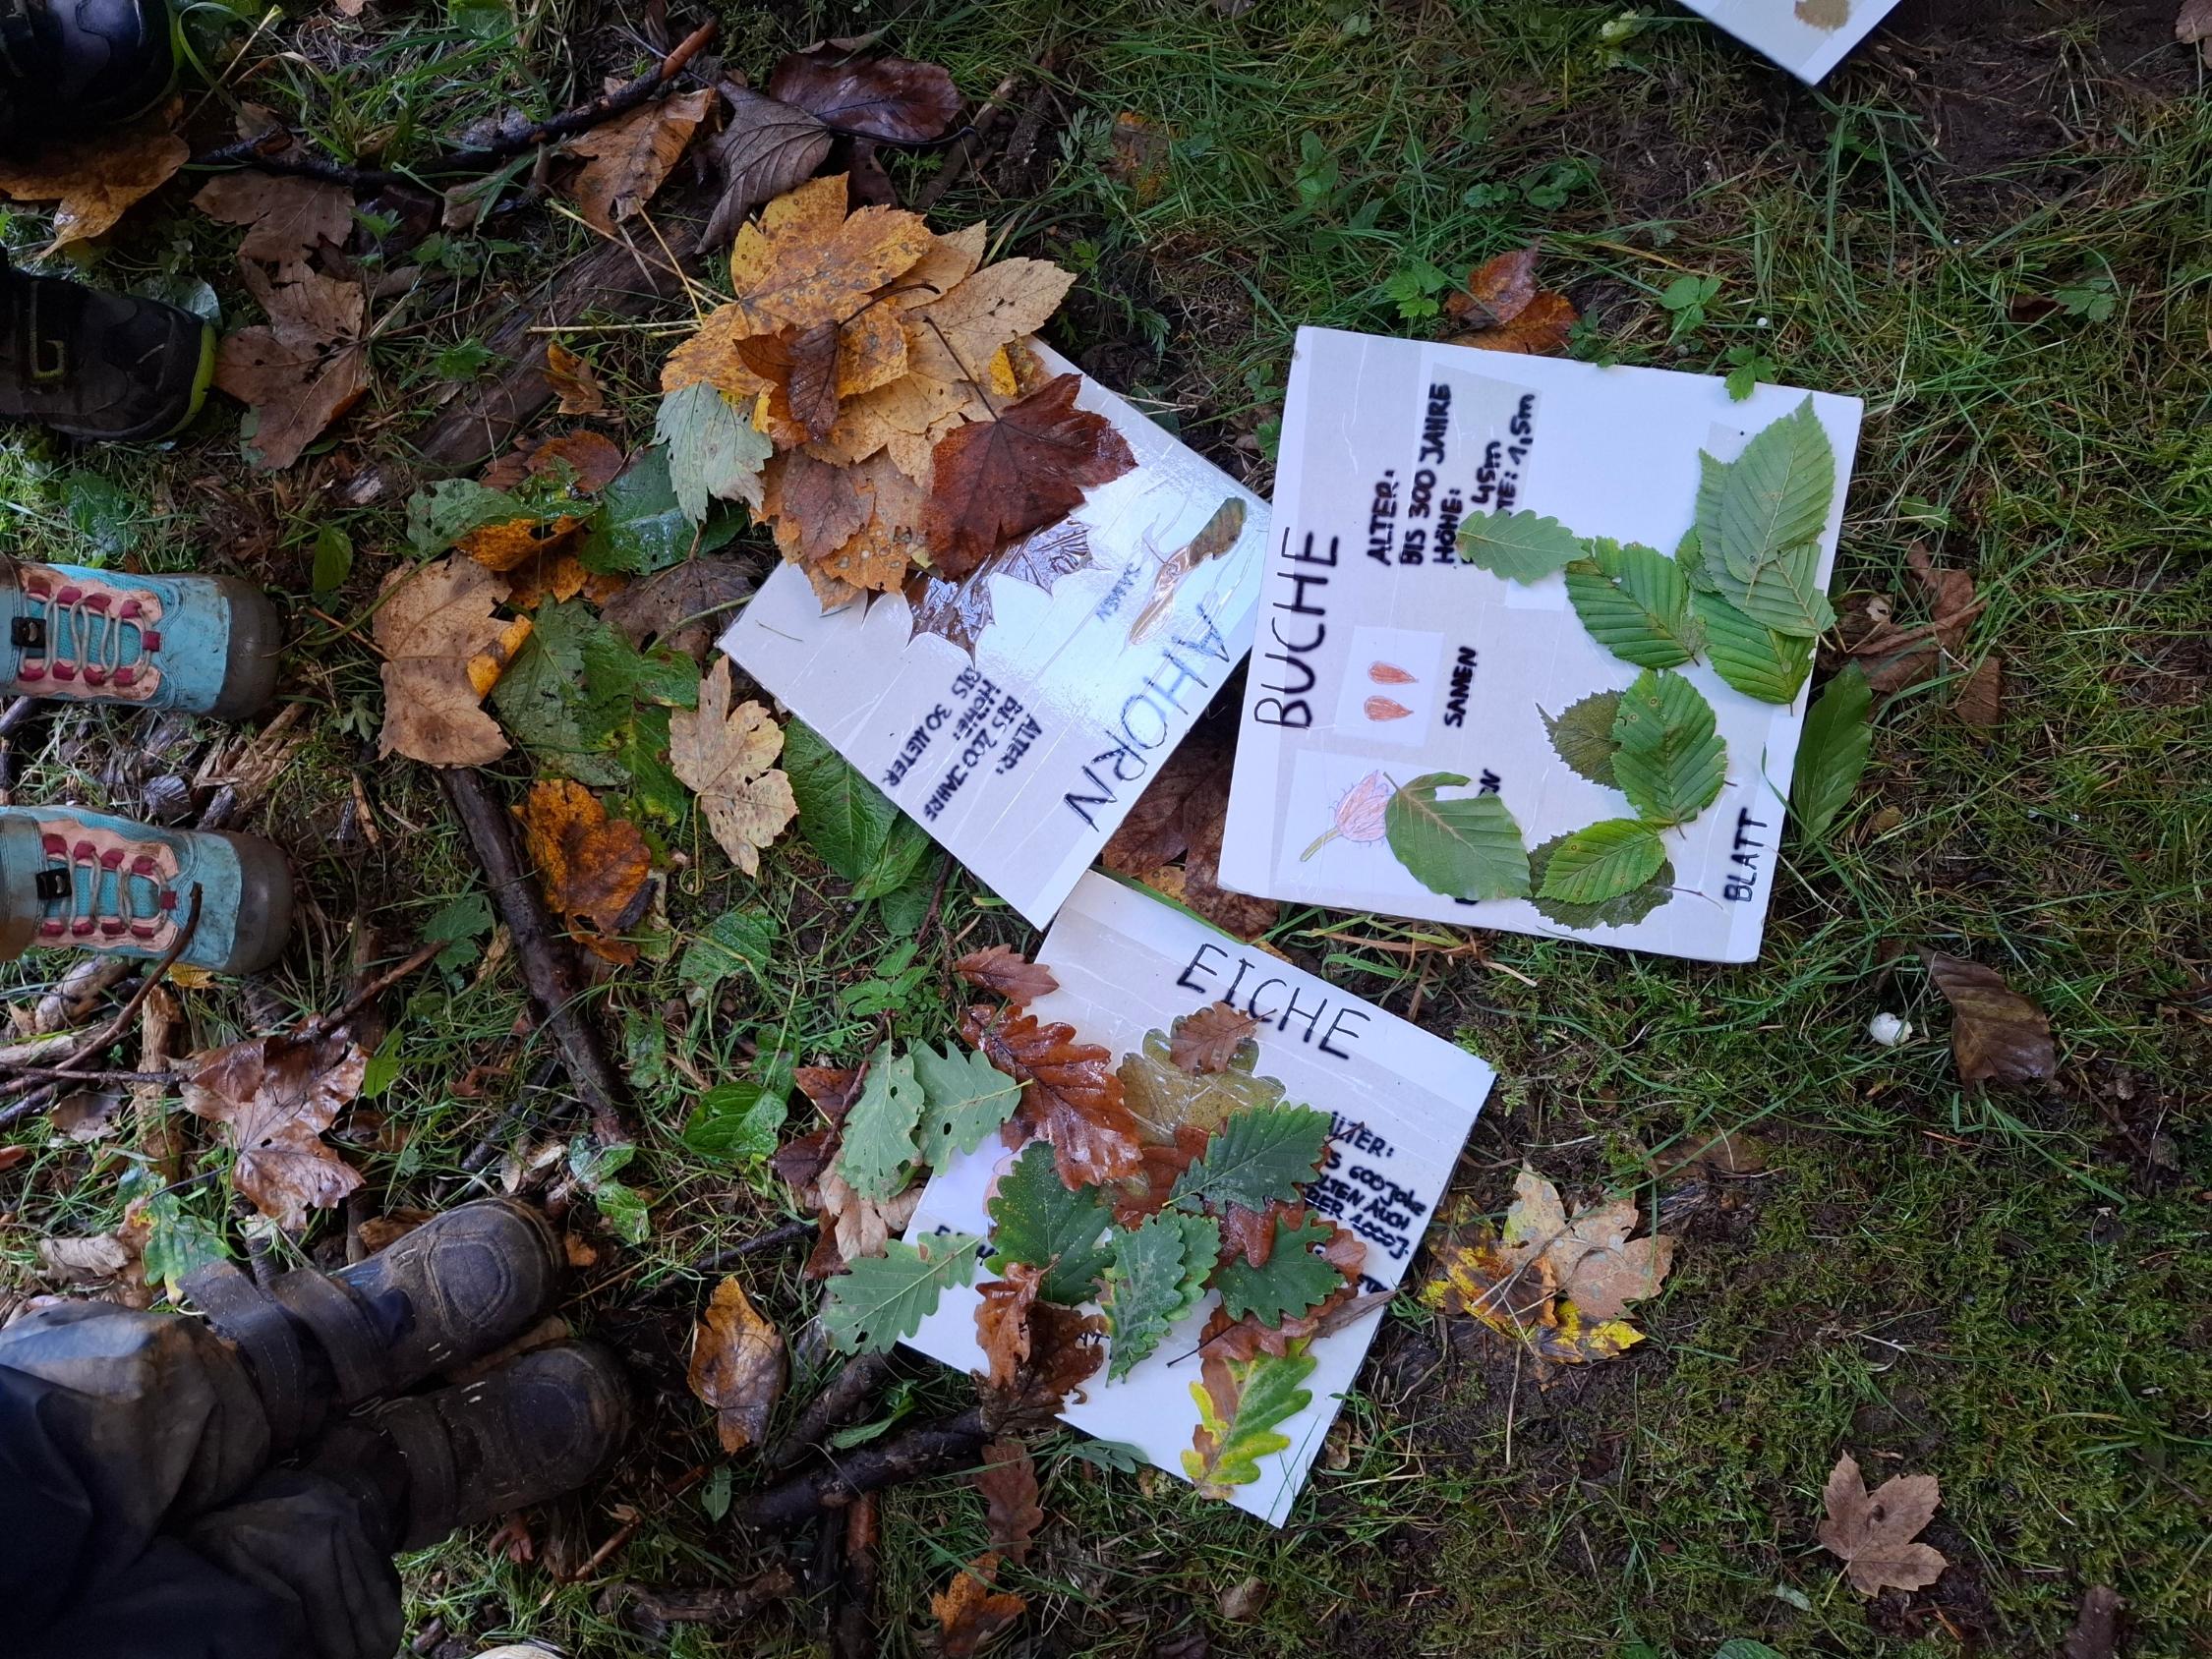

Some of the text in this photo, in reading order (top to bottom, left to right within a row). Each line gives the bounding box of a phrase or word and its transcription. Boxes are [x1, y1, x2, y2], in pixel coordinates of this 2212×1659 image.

[1399, 383, 1452, 566] BIS 300 JAHRE
[1432, 488, 1463, 564] HÖHE:
[1254, 527, 1339, 730] BUCHE
[951, 665, 981, 700] BIS
[953, 678, 1002, 741] HÖHE:
[1063, 602, 1230, 833] AHORN
[1444, 646, 1478, 727] SAMEN
[923, 695, 1023, 822] BIS 200 JAHRE
[996, 713, 1043, 775] ALTER:
[1723, 807, 1768, 902] BLATT
[1177, 943, 1371, 1060] EICHE
[1363, 1195, 1411, 1230] AUCH
